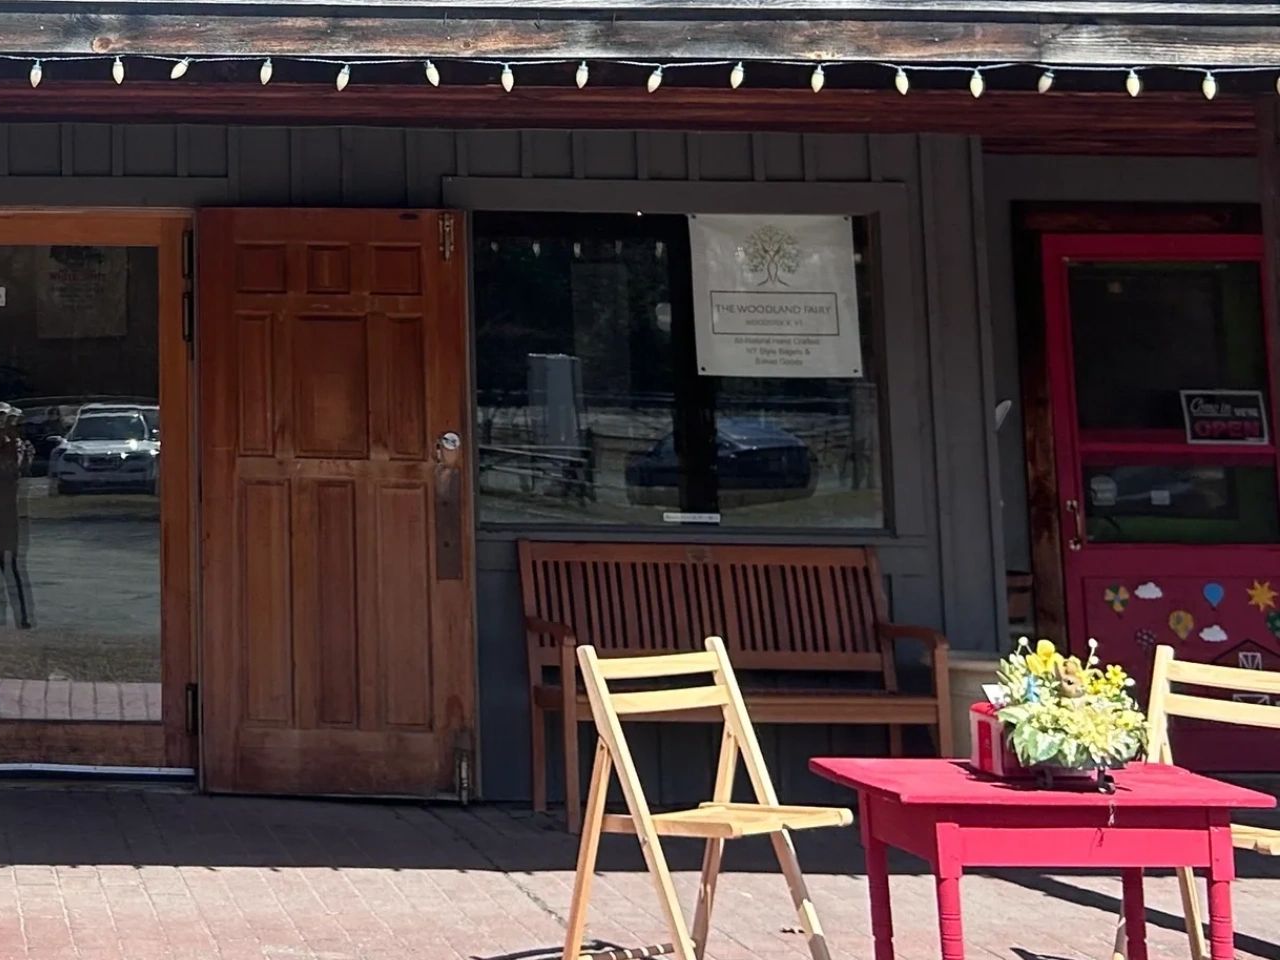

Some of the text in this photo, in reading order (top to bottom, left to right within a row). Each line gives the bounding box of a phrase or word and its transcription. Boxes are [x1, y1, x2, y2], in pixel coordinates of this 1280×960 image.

[716, 304, 831, 314] THE WOODLAND FAIRY
[1194, 420, 1260, 436] OPEN
